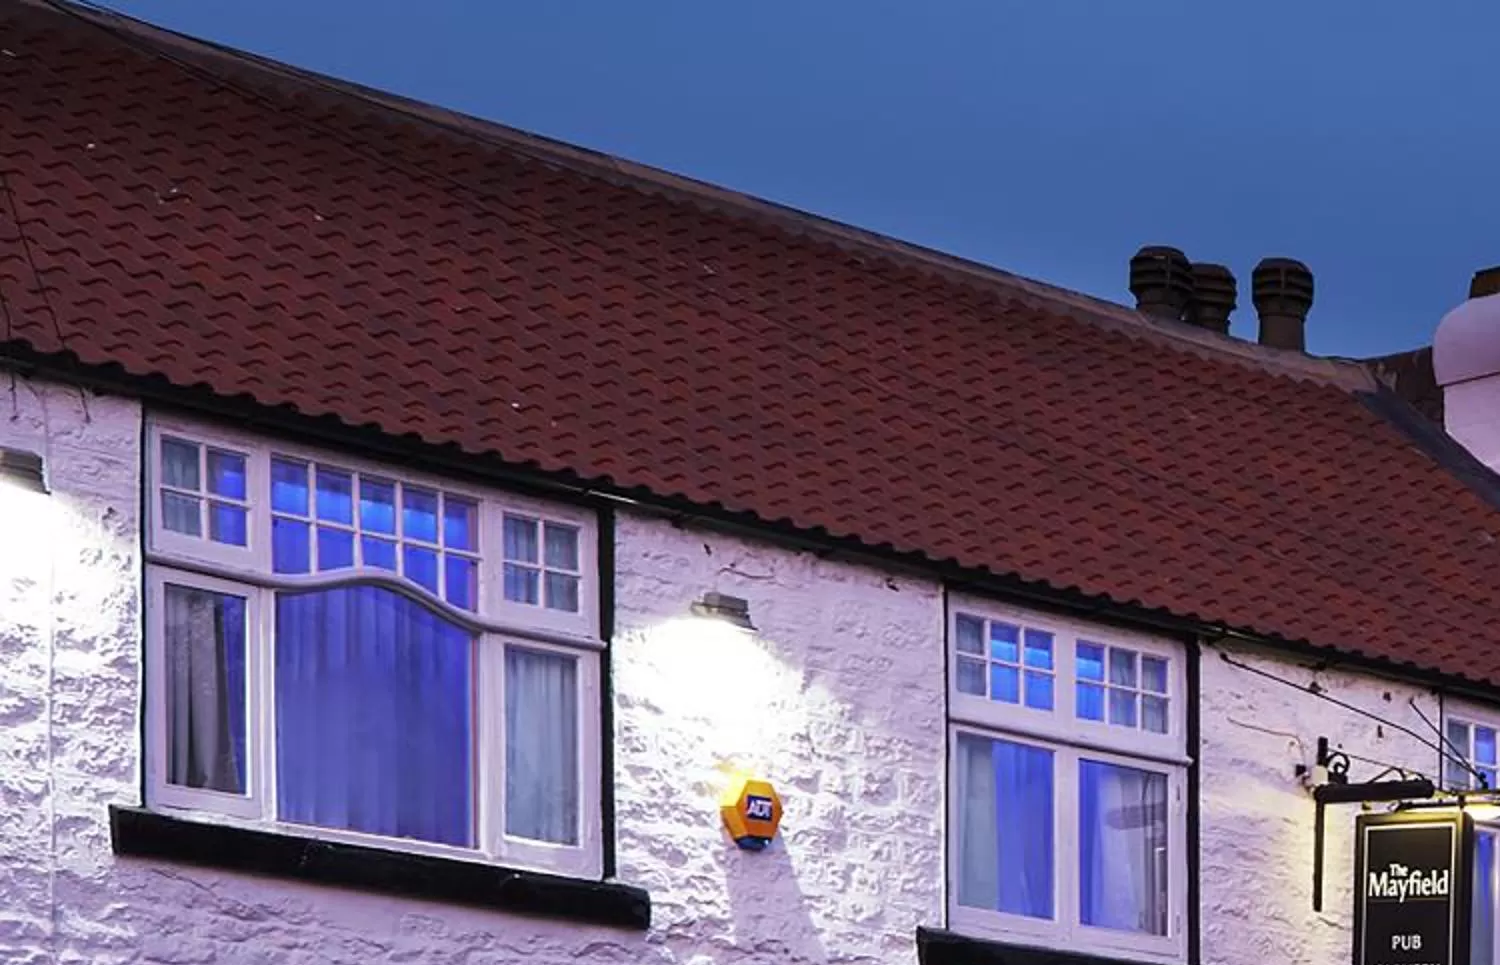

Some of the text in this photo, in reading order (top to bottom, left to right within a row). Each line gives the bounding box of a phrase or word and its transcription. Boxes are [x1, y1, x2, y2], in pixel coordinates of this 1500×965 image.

[745, 799, 773, 818] ADT
[1389, 863, 1409, 877] The
[1368, 869, 1449, 903] Mayfield
[1391, 934, 1422, 950] PUB
